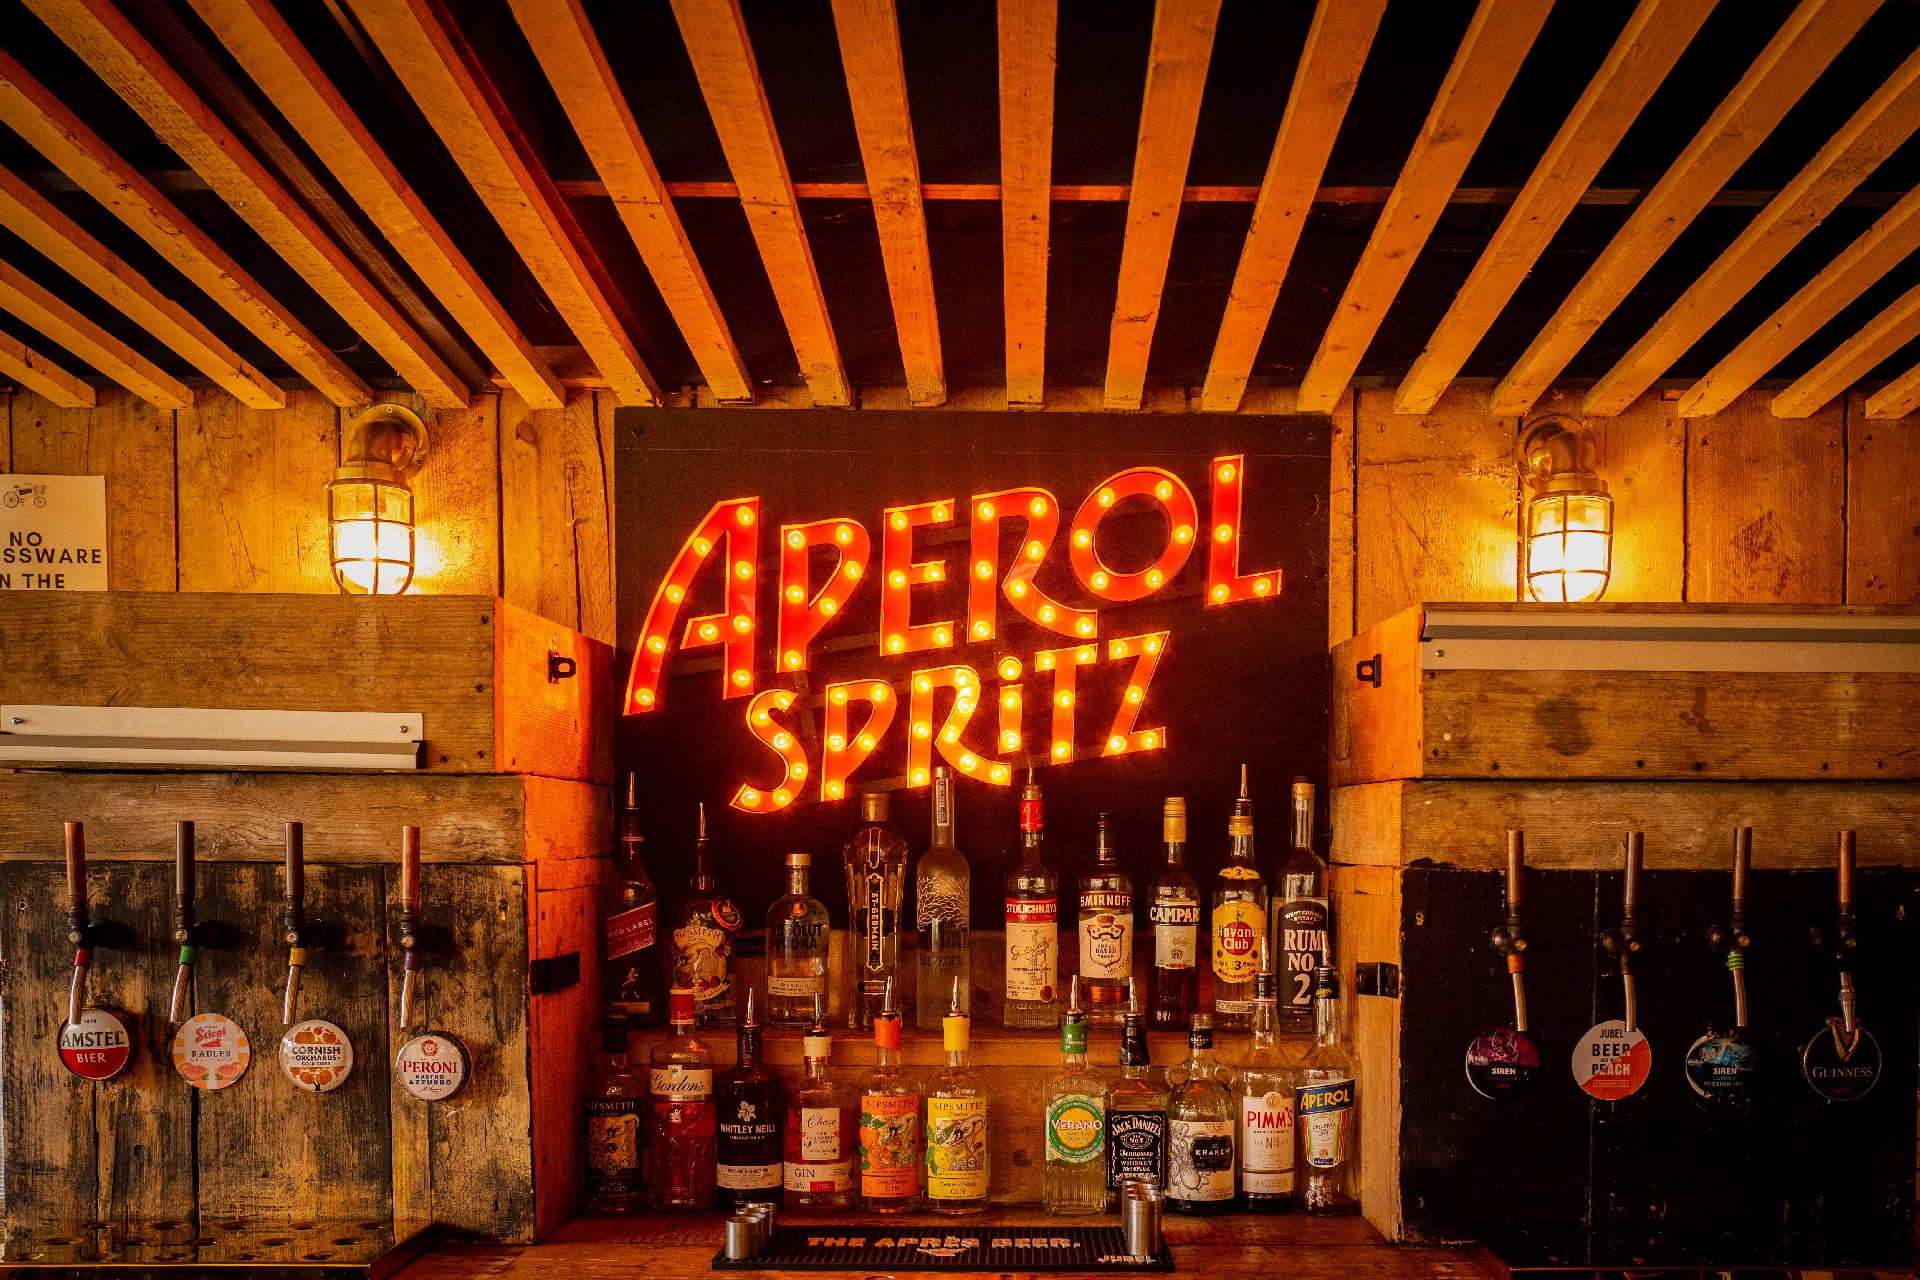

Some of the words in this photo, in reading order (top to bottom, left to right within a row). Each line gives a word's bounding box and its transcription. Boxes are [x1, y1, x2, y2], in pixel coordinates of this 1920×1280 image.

[9, 531, 43, 547] NO
[21, 573, 65, 589] THE
[622, 453, 1283, 716] APEROL
[1080, 894, 1131, 907] SMIRNOFF
[1006, 902, 1057, 915] STOLICHNAYA
[1149, 906, 1201, 923] CAMPAR
[626, 917, 654, 933] LABEL
[871, 892, 879, 951] ST-GERMAIN
[770, 923, 823, 937] ABOLUT
[1217, 924, 1258, 938] Havana
[776, 936, 817, 950] VDKA
[1223, 937, 1250, 950] Club
[1283, 929, 1325, 952] RUM
[1234, 960, 1242, 970] 3
[1287, 952, 1315, 972] NO
[1292, 973, 1312, 1005] 2
[62, 1030, 124, 1048] AMSTEL
[1599, 1028, 1624, 1039] JUBEL
[191, 1050, 231, 1058] RADLER
[292, 1046, 341, 1055] CORNISH
[1592, 1043, 1631, 1057] BEER
[76, 1052, 107, 1063] BIER
[295, 1054, 337, 1062] ORCHARDS
[402, 1060, 459, 1073] PERONI
[1491, 1067, 1517, 1075] SIREN
[1591, 1063, 1631, 1076] PEACH
[1713, 1067, 1738, 1075] SIREN
[1812, 1066, 1873, 1078] GUINNESS
[651, 1072, 704, 1092] Gordon's
[866, 1099, 915, 1108] SIPSMITH
[933, 1101, 983, 1111] SIPSMITH
[1300, 1089, 1350, 1111] APEROL
[1247, 1106, 1293, 1129] PIMM'S
[720, 1123, 754, 1134] WHITLEY
[755, 1123, 776, 1134] NEILL
[1051, 1119, 1103, 1131] VERANO
[1111, 1120, 1133, 1136] JACK
[1195, 1147, 1231, 1156] KRAKEN
[794, 1168, 815, 1179] GIN
[807, 1236, 868, 1248] THE
